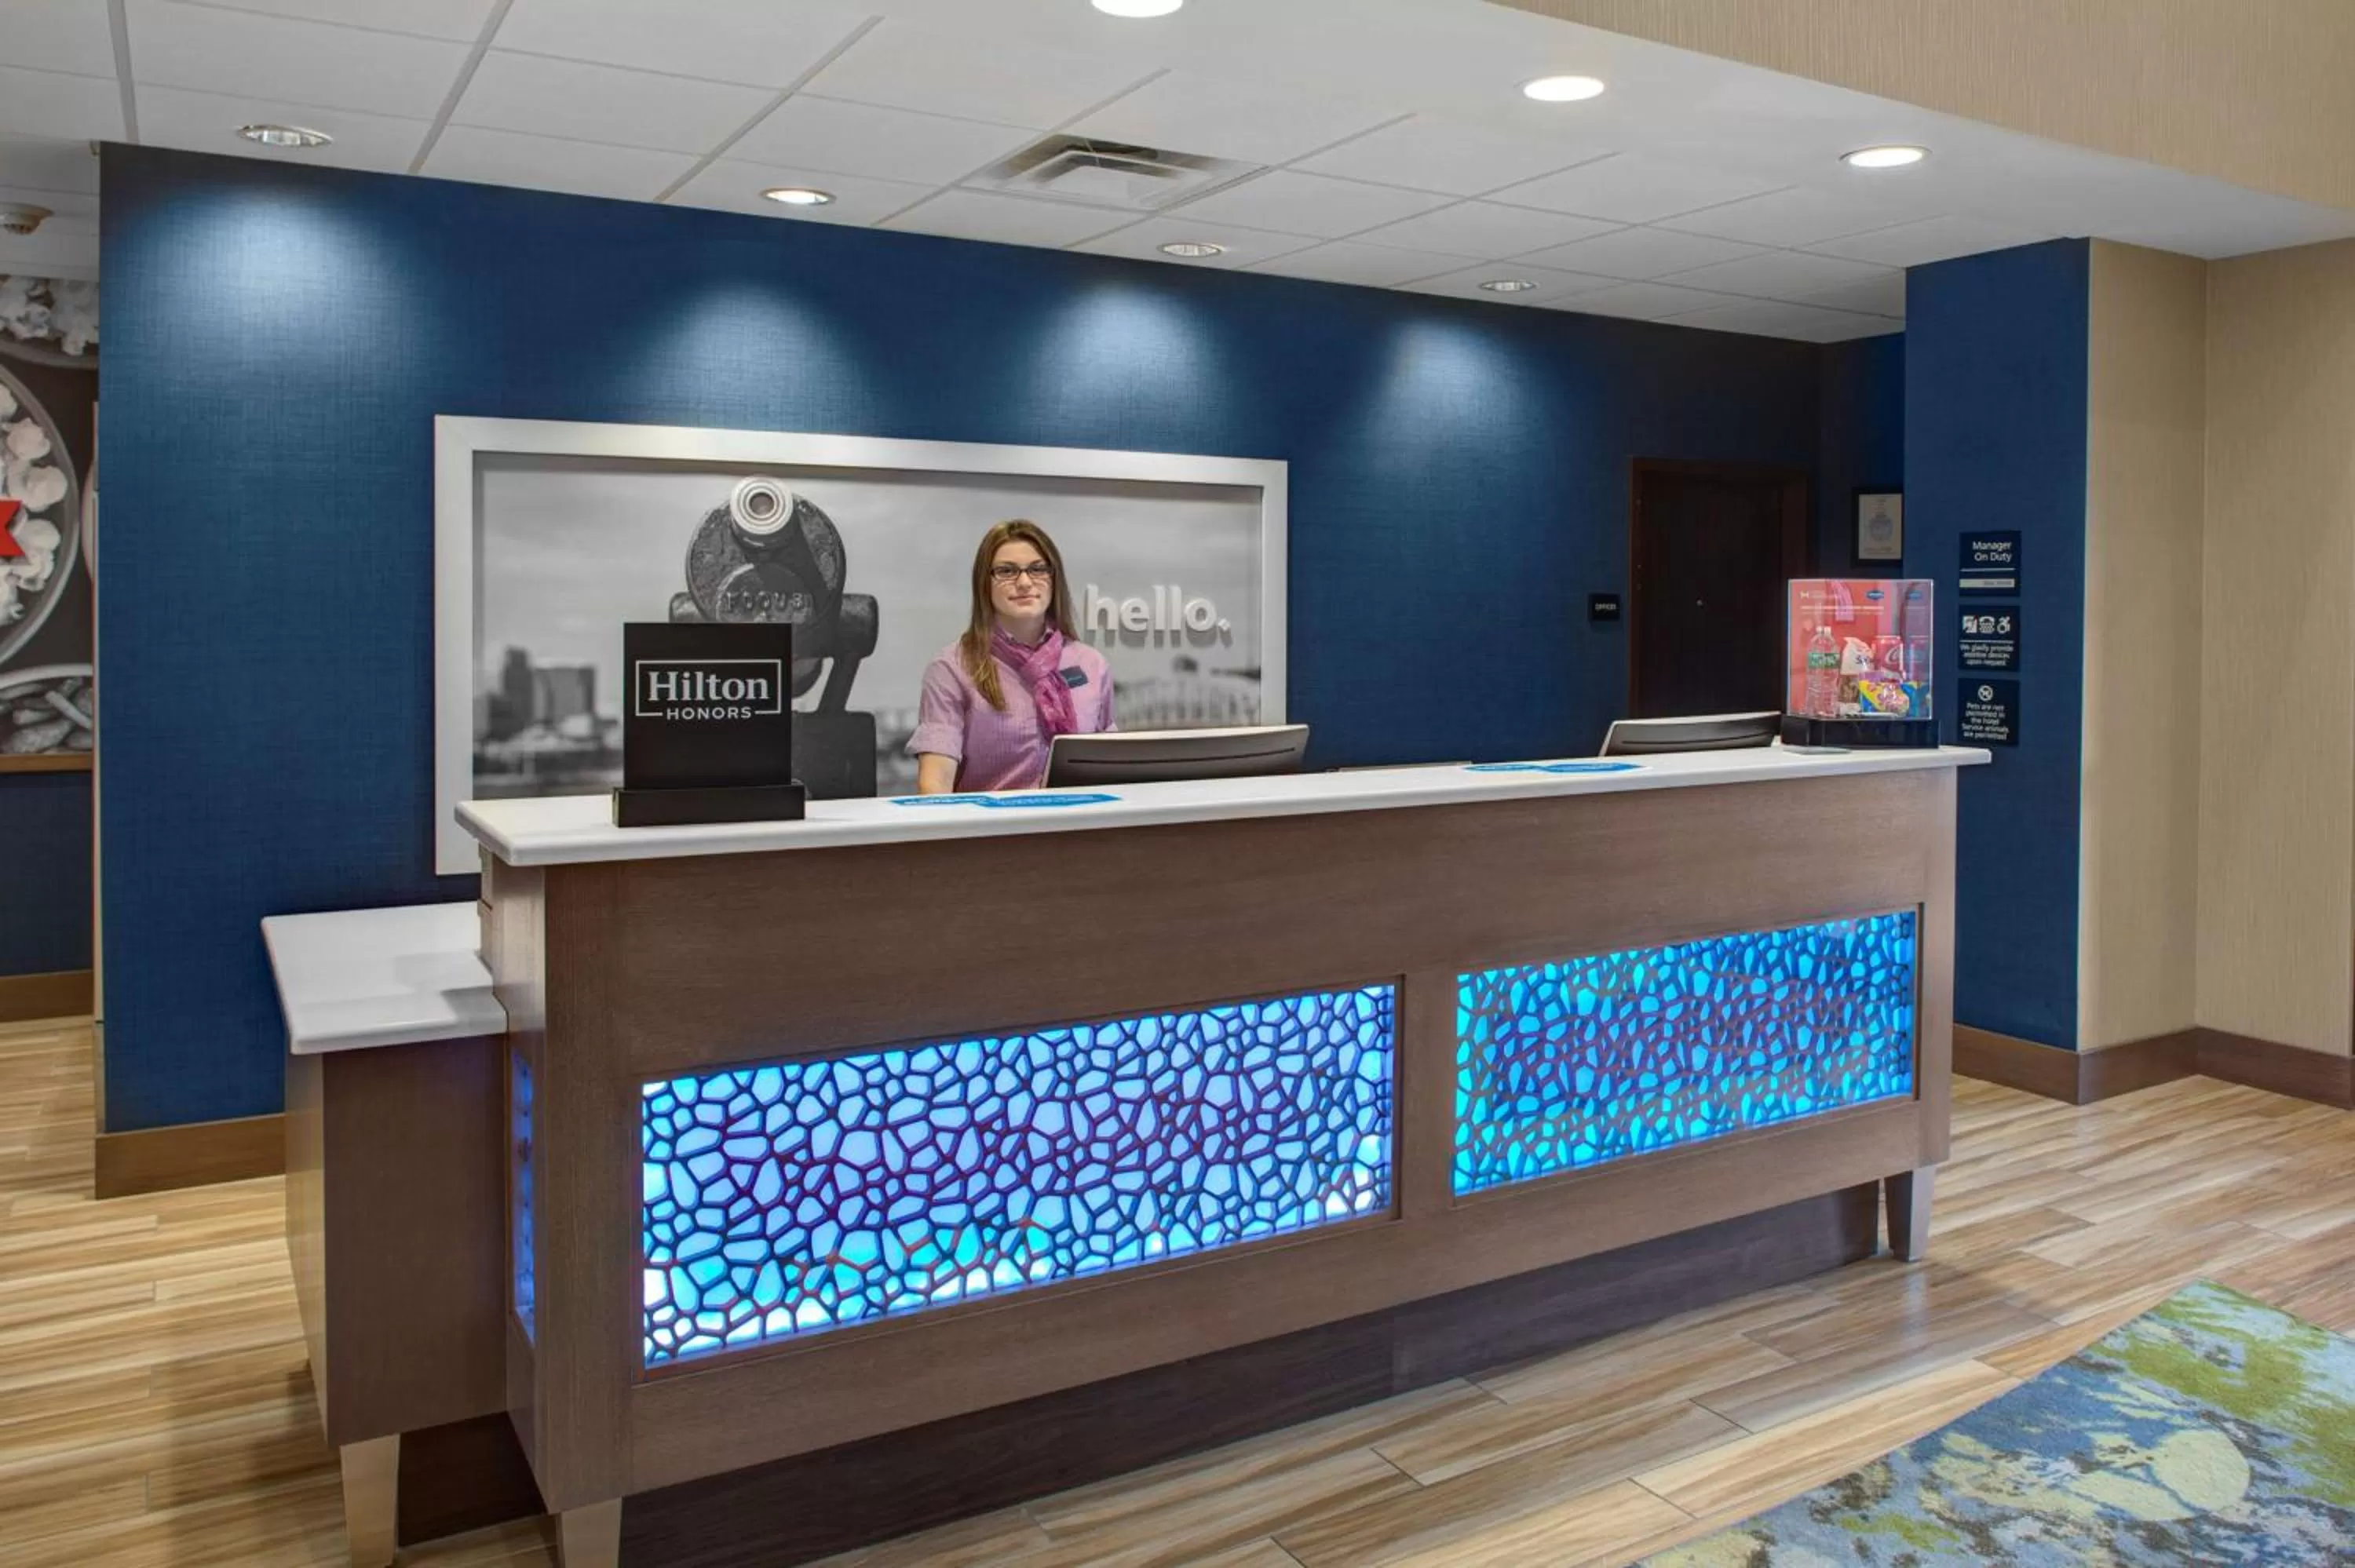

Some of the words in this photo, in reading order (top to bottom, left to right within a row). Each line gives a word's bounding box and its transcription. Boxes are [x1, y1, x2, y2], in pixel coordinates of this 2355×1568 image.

[1972, 542, 2011, 552] Manager
[1974, 552, 1988, 561] On
[1990, 552, 2012, 563] Duty
[1086, 584, 1230, 632] hello.
[648, 671, 769, 701] Hilton
[667, 706, 752, 720] HONORS
